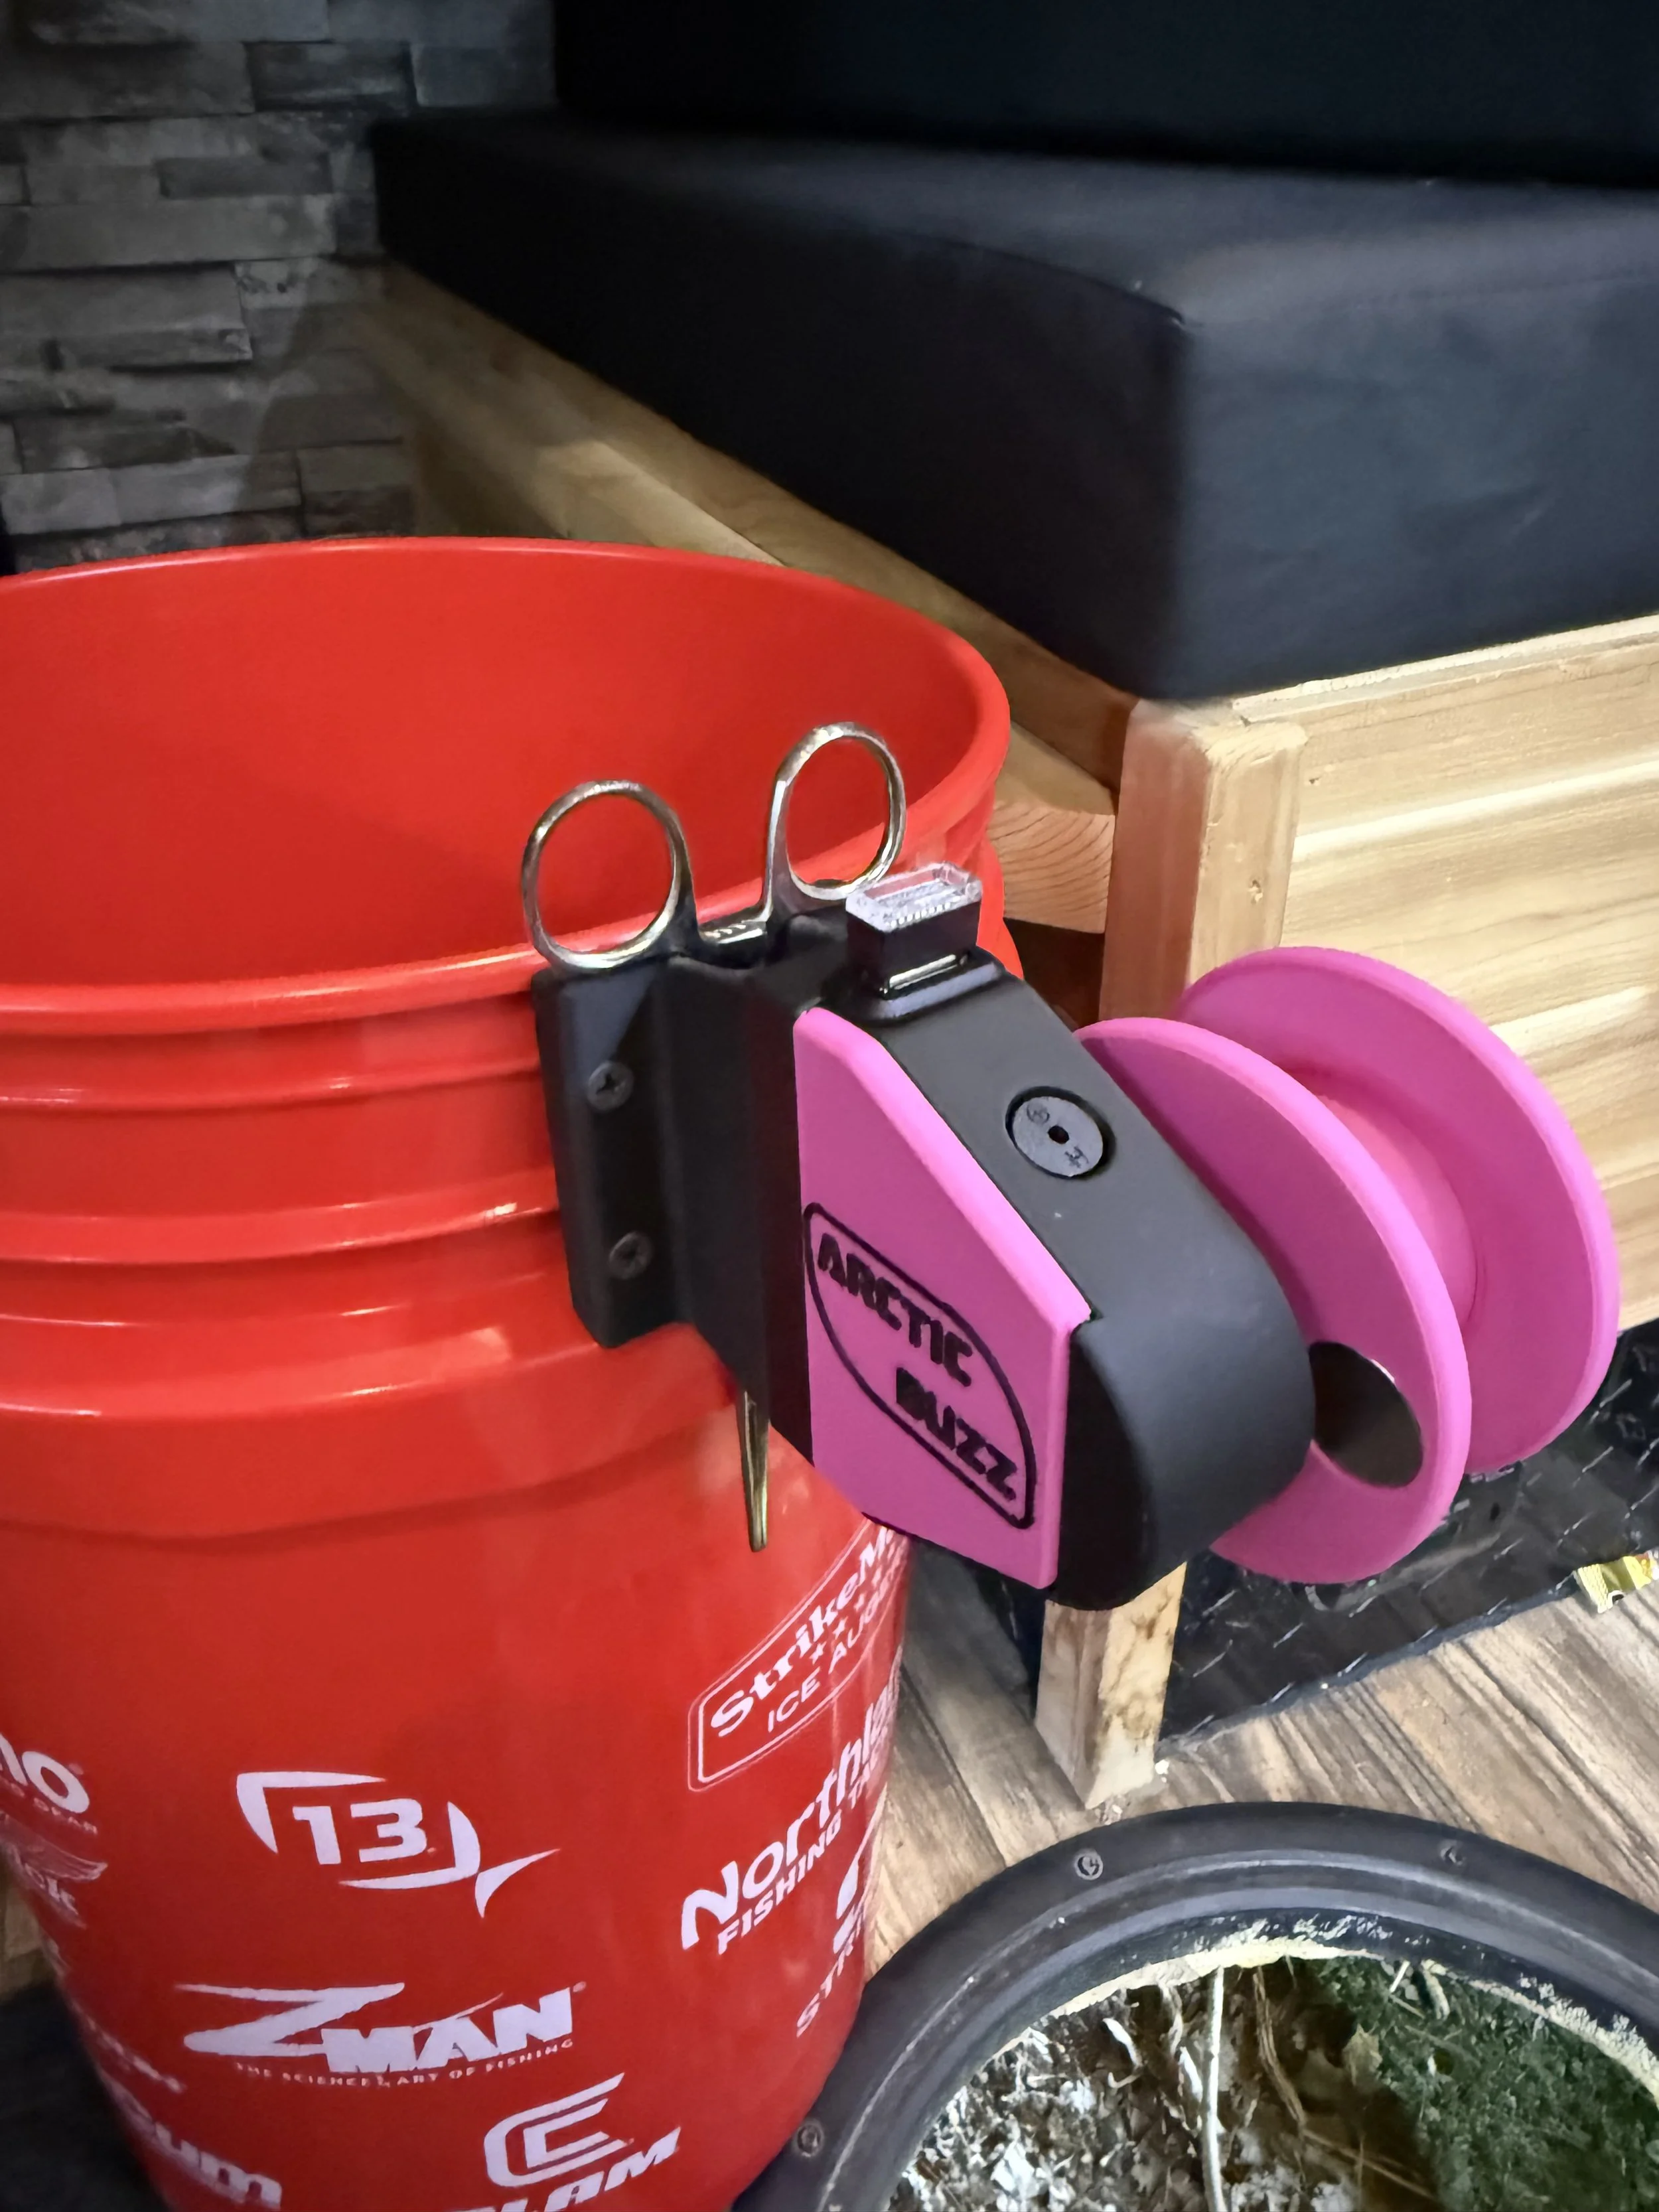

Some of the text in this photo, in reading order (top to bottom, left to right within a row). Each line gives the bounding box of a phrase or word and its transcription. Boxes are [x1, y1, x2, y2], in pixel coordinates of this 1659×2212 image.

[818, 1232, 974, 1387] ARCTIC
[895, 1367, 1018, 1501] BUZZ
[767, 1666, 821, 1733] ICE
[292, 1798, 428, 1866] 13
[717, 1809, 842, 1955] FISHING
